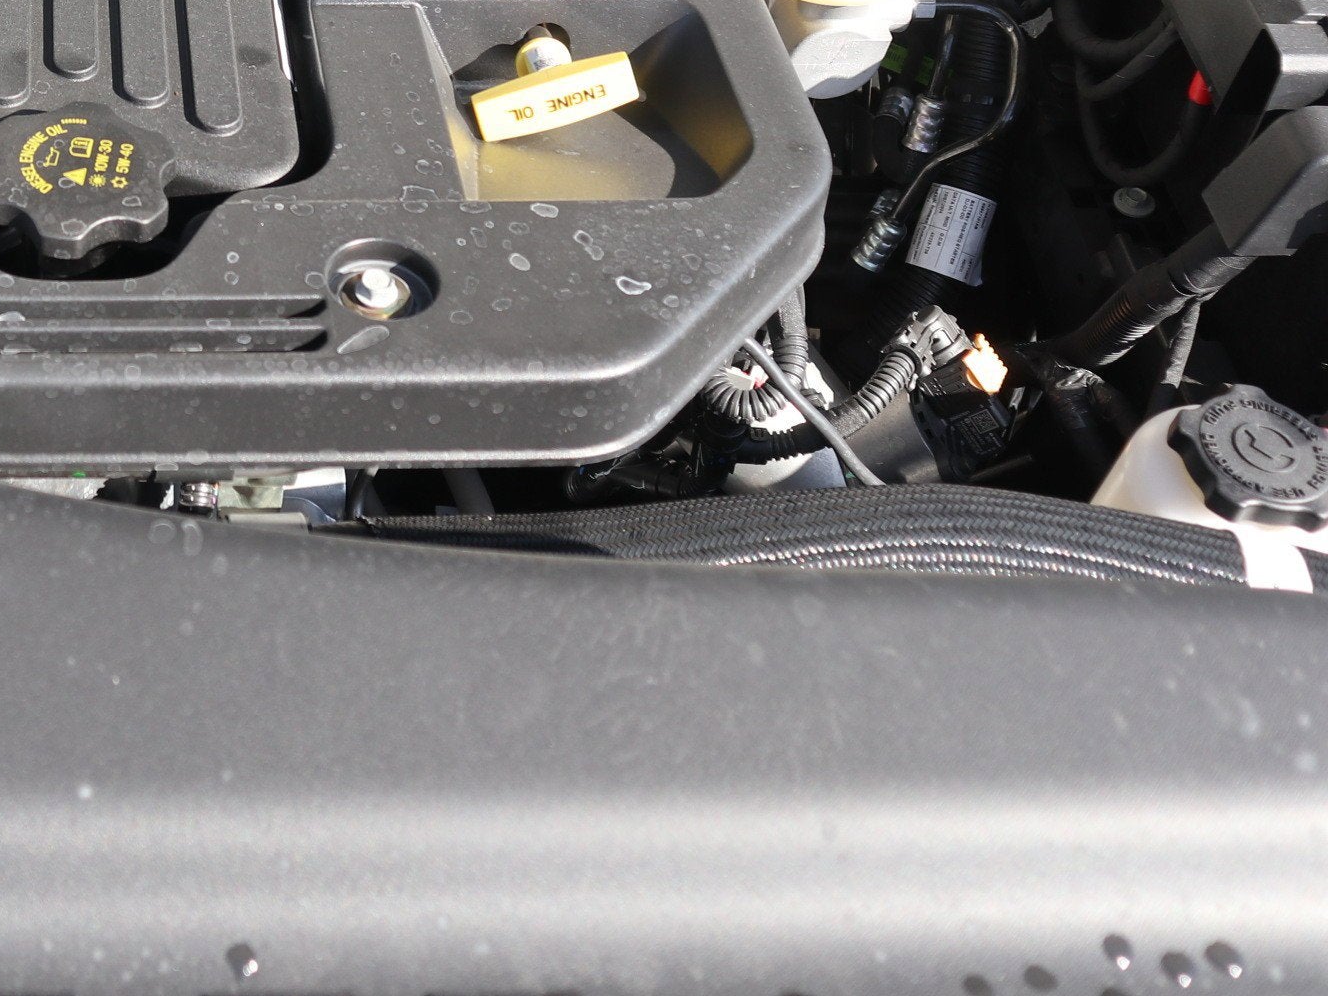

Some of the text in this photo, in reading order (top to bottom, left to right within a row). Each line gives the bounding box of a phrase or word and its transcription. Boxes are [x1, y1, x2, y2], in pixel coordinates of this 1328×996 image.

[508, 84, 607, 122] ENGINE OIL
[19, 123, 69, 194] DIESEL ENGINE OIL
[94, 139, 113, 172] 10W-30
[115, 143, 134, 175] 5W-40
[1204, 400, 1236, 425] FLUID
[1239, 399, 1319, 442] STEERING
[1200, 432, 1306, 498] USE APPROVED
